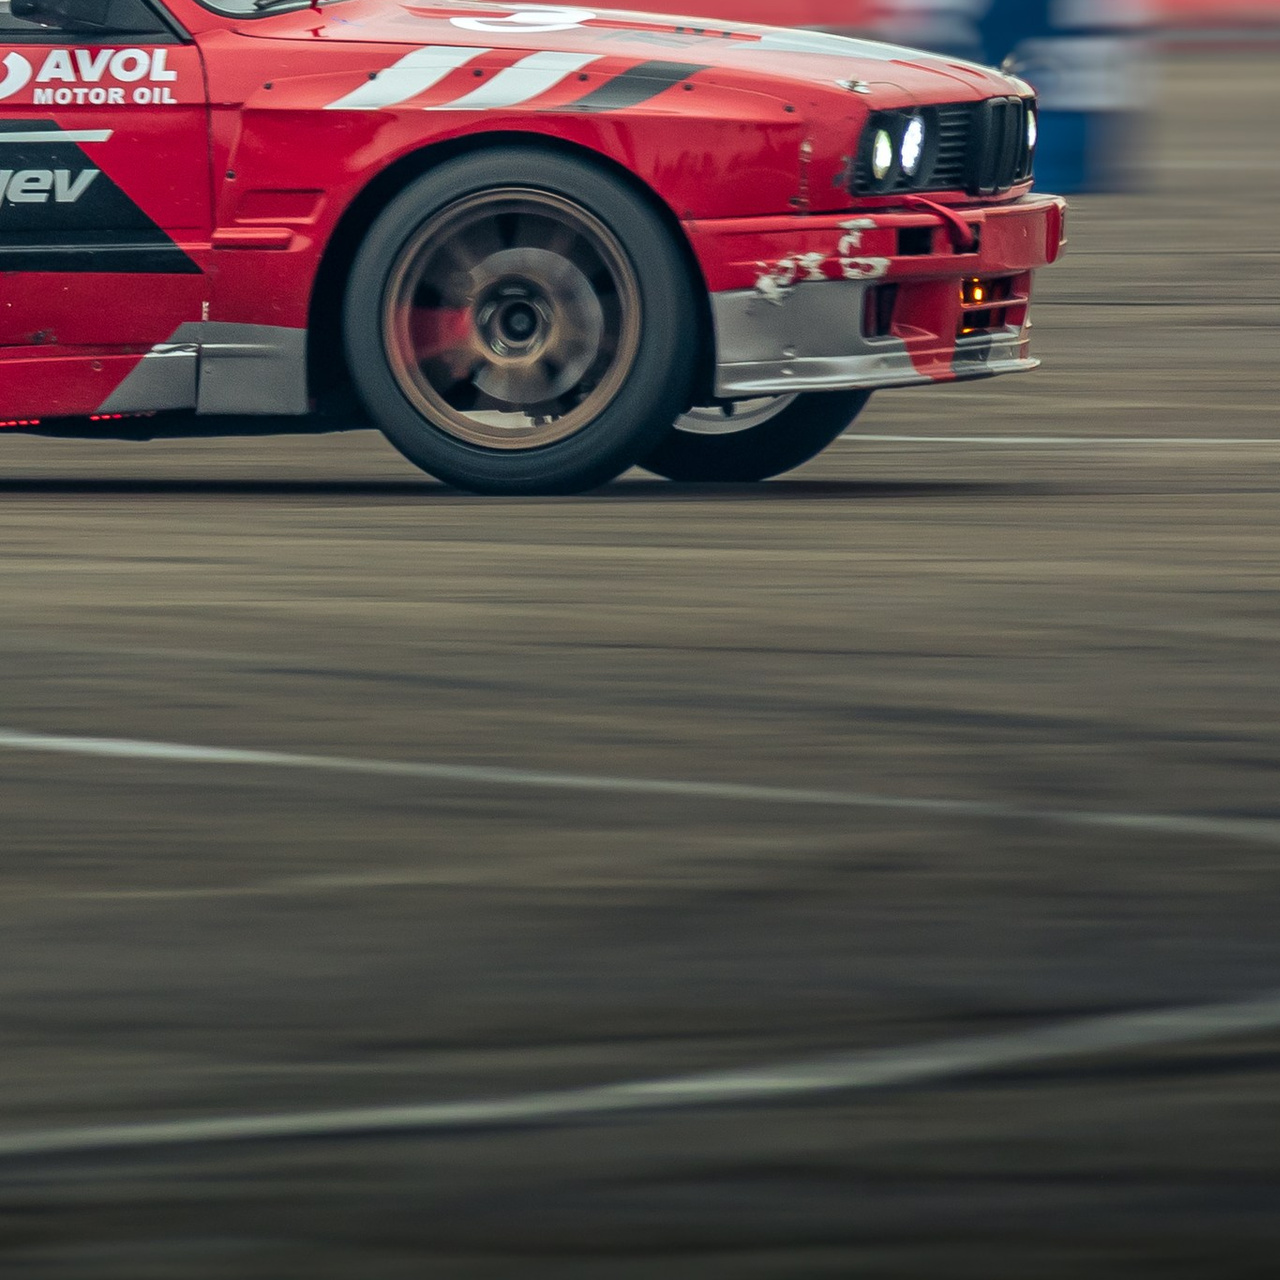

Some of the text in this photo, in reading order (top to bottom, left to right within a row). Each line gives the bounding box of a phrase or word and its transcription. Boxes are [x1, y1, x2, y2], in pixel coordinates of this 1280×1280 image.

[35, 49, 177, 82] AVOL
[33, 88, 177, 104] MOTOR OIL
